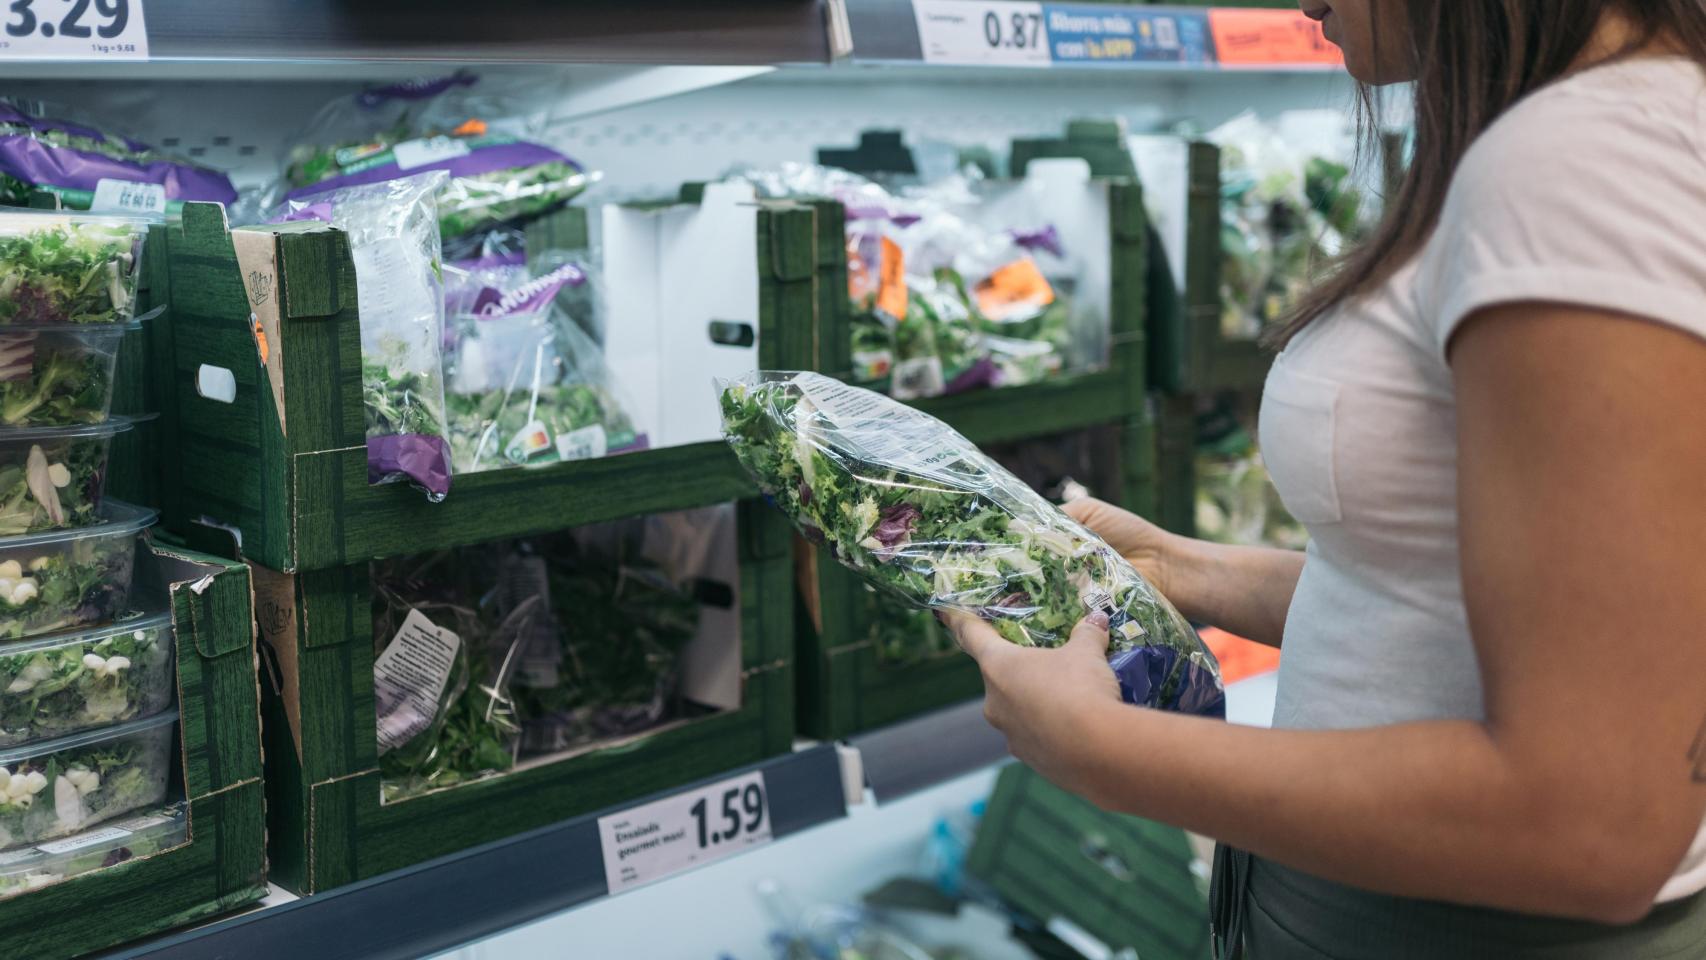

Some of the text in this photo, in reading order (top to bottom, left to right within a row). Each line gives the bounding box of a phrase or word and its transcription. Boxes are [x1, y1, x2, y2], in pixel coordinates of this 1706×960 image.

[5, 0, 129, 38] 3.29
[985, 11, 1041, 48] 0.87
[615, 821, 660, 843] Ensalada
[690, 783, 763, 848] 1.59
[617, 838, 660, 860] gourmet
